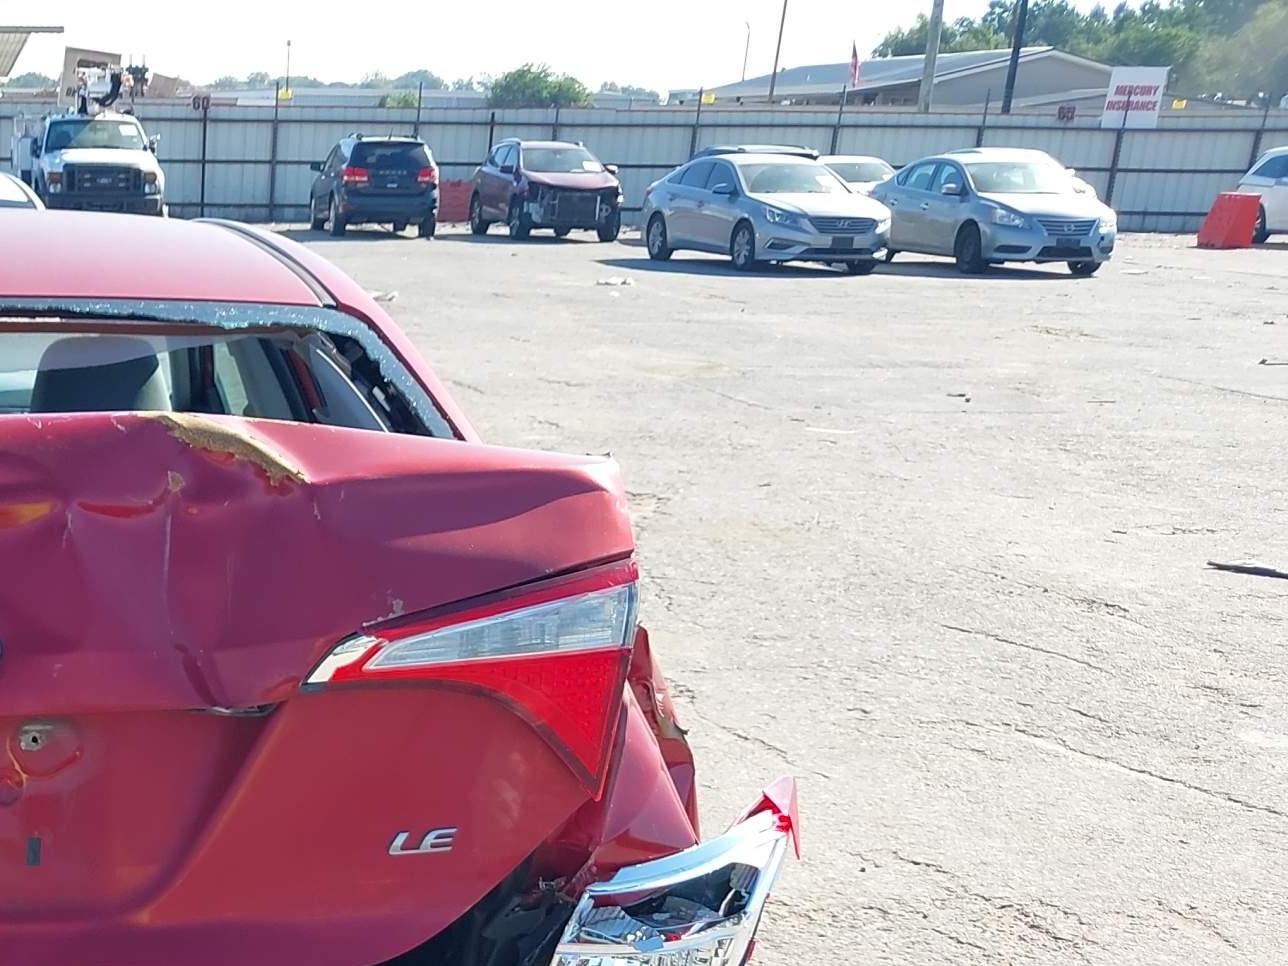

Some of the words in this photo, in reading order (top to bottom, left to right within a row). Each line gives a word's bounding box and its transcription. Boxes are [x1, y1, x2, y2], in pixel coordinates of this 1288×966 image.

[1114, 85, 1160, 97] MERCURY
[1105, 100, 1159, 111] INSURANCE
[388, 827, 458, 855] LE
